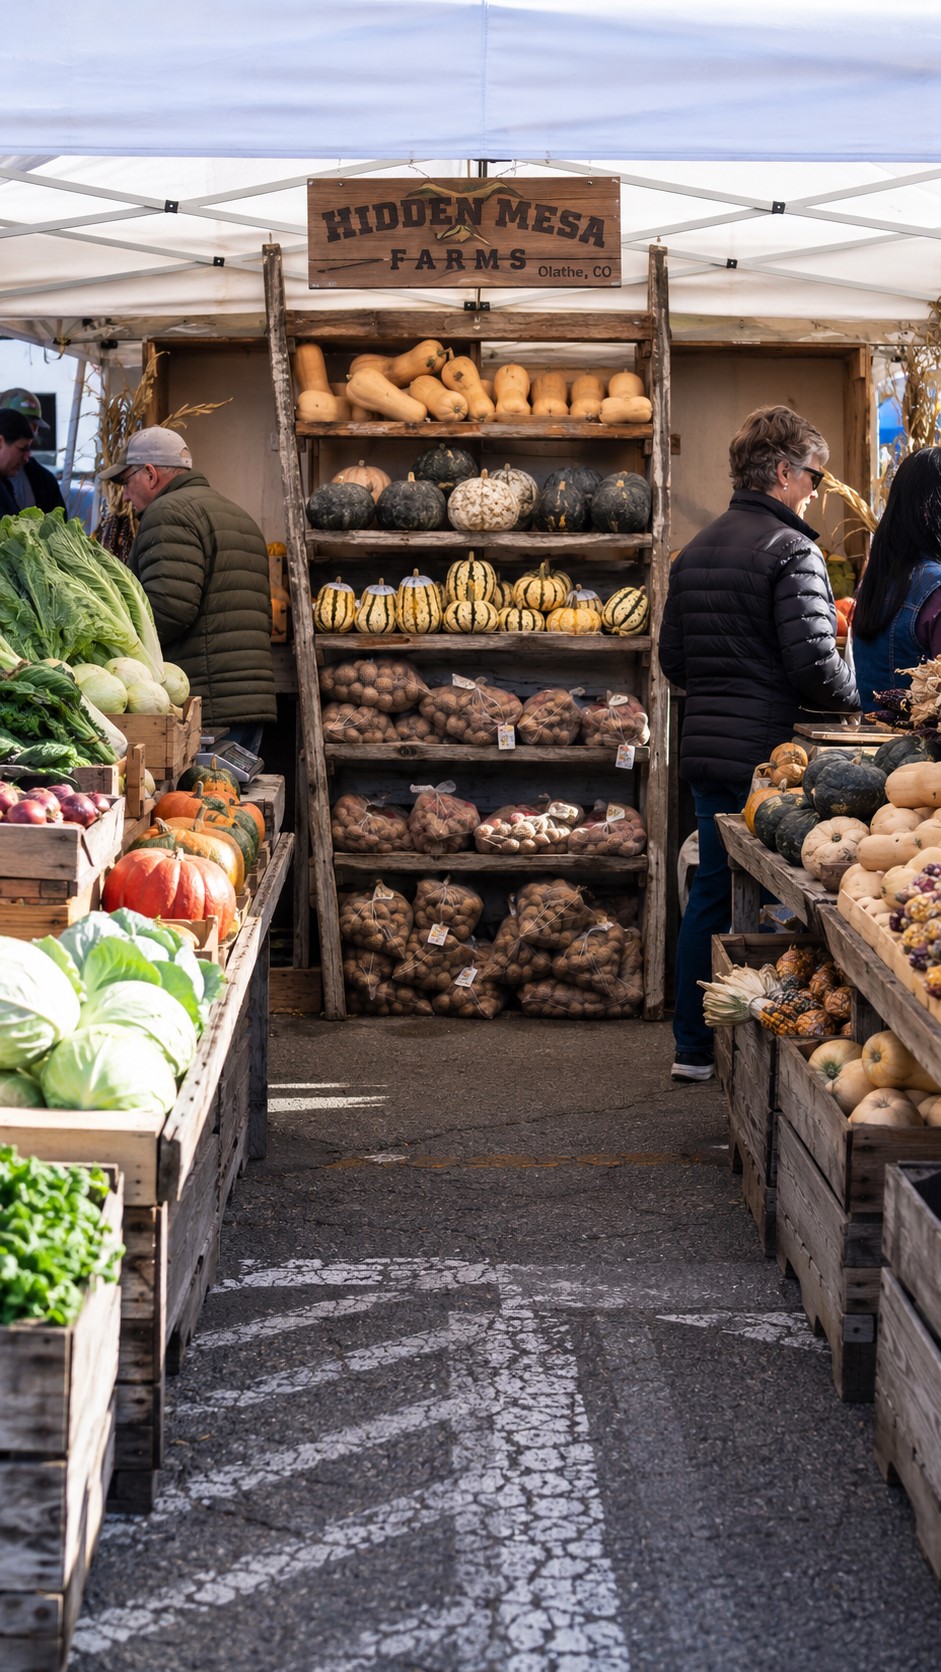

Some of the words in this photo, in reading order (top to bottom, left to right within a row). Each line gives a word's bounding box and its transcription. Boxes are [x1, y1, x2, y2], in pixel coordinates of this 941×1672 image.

[321, 197, 485, 243] HIDDEN
[495, 197, 605, 248] MESA
[390, 248, 527, 270] FARMS
[538, 265, 588, 279] Olathe,
[593, 265, 612, 278] CO
